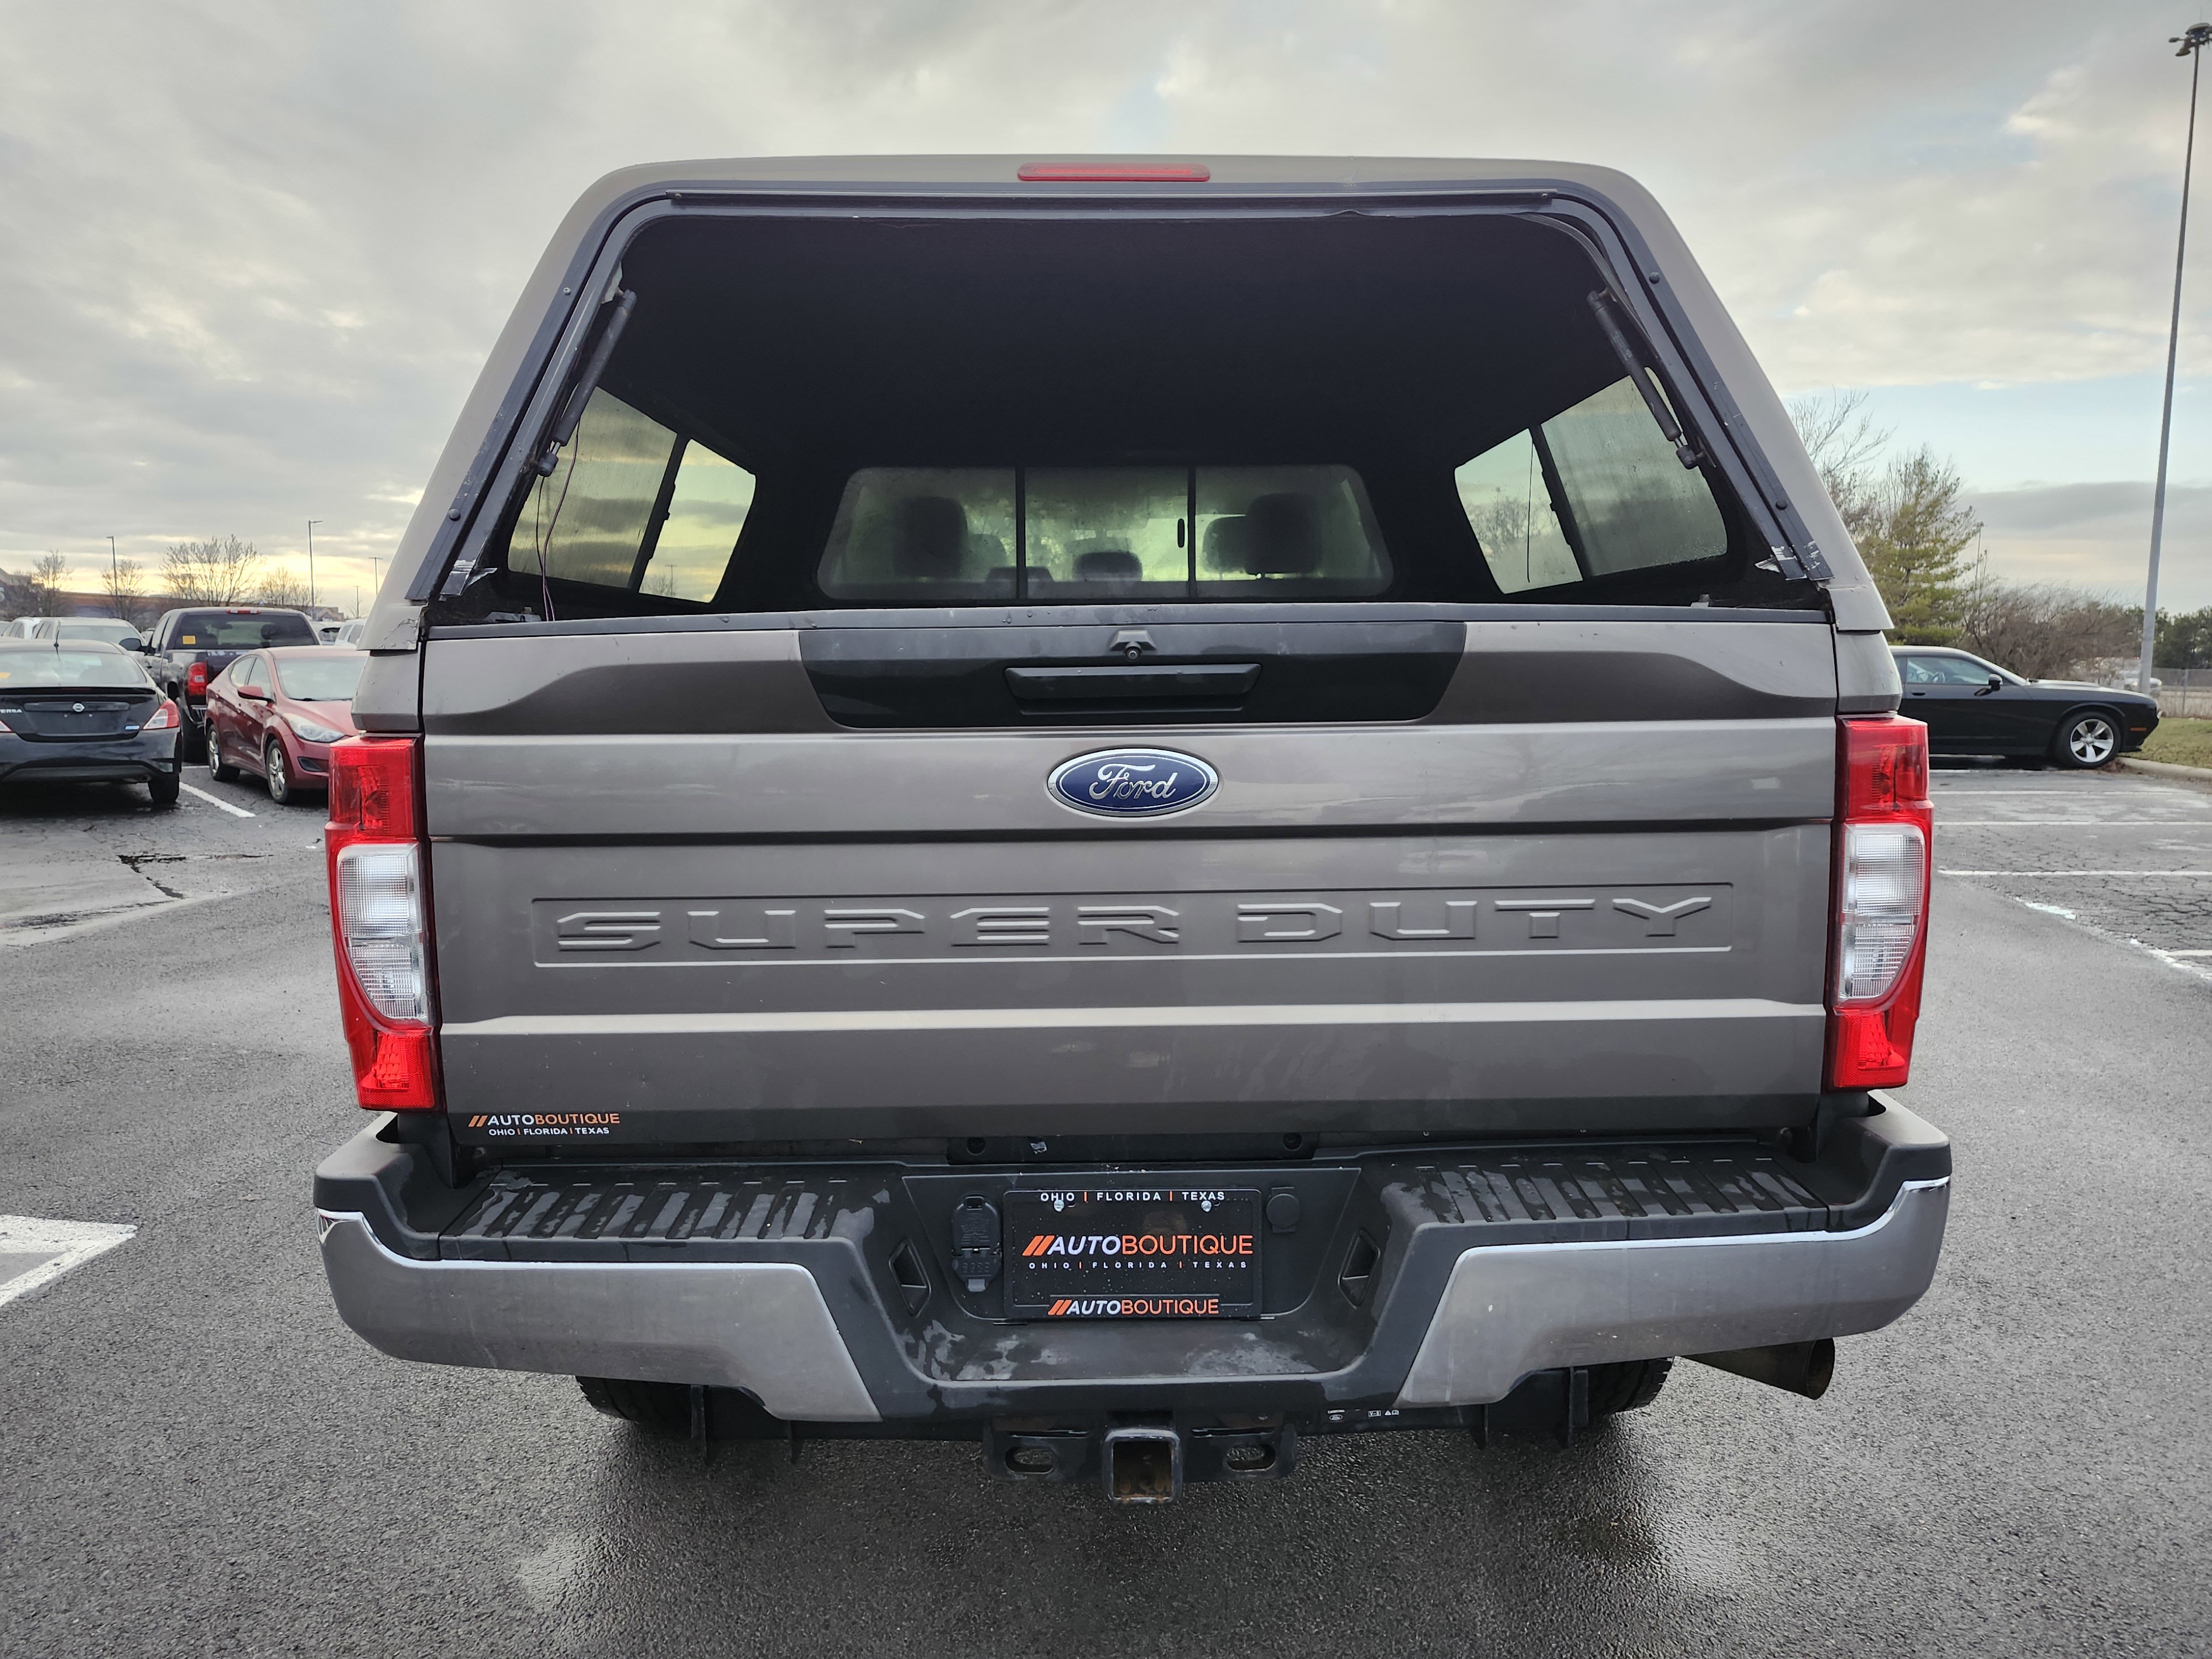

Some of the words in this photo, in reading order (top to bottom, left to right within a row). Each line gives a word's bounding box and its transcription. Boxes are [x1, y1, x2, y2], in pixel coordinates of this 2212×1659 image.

[1088, 763, 1179, 800] Ford
[557, 905, 1179, 952] SUPER
[1237, 896, 1713, 942] DUTY
[487, 1113, 620, 1126] AUTOBOUTIQUE
[488, 1128, 515, 1136] OHIO
[523, 1128, 568, 1136] FLORIDA
[574, 1127, 610, 1135] TEXAS
[1040, 1192, 1075, 1202] OHIO
[1096, 1191, 1162, 1202] FLORIDA
[1181, 1191, 1226, 1201] TEXAS
[1047, 1234, 1254, 1255] AUTOBOUTIQUE
[1028, 1261, 1071, 1270] OHIO
[1092, 1261, 1168, 1270] FLORIDA
[1192, 1261, 1248, 1269] TEXAS
[1066, 1298, 1219, 1315] AUTOBOUTIQUE
